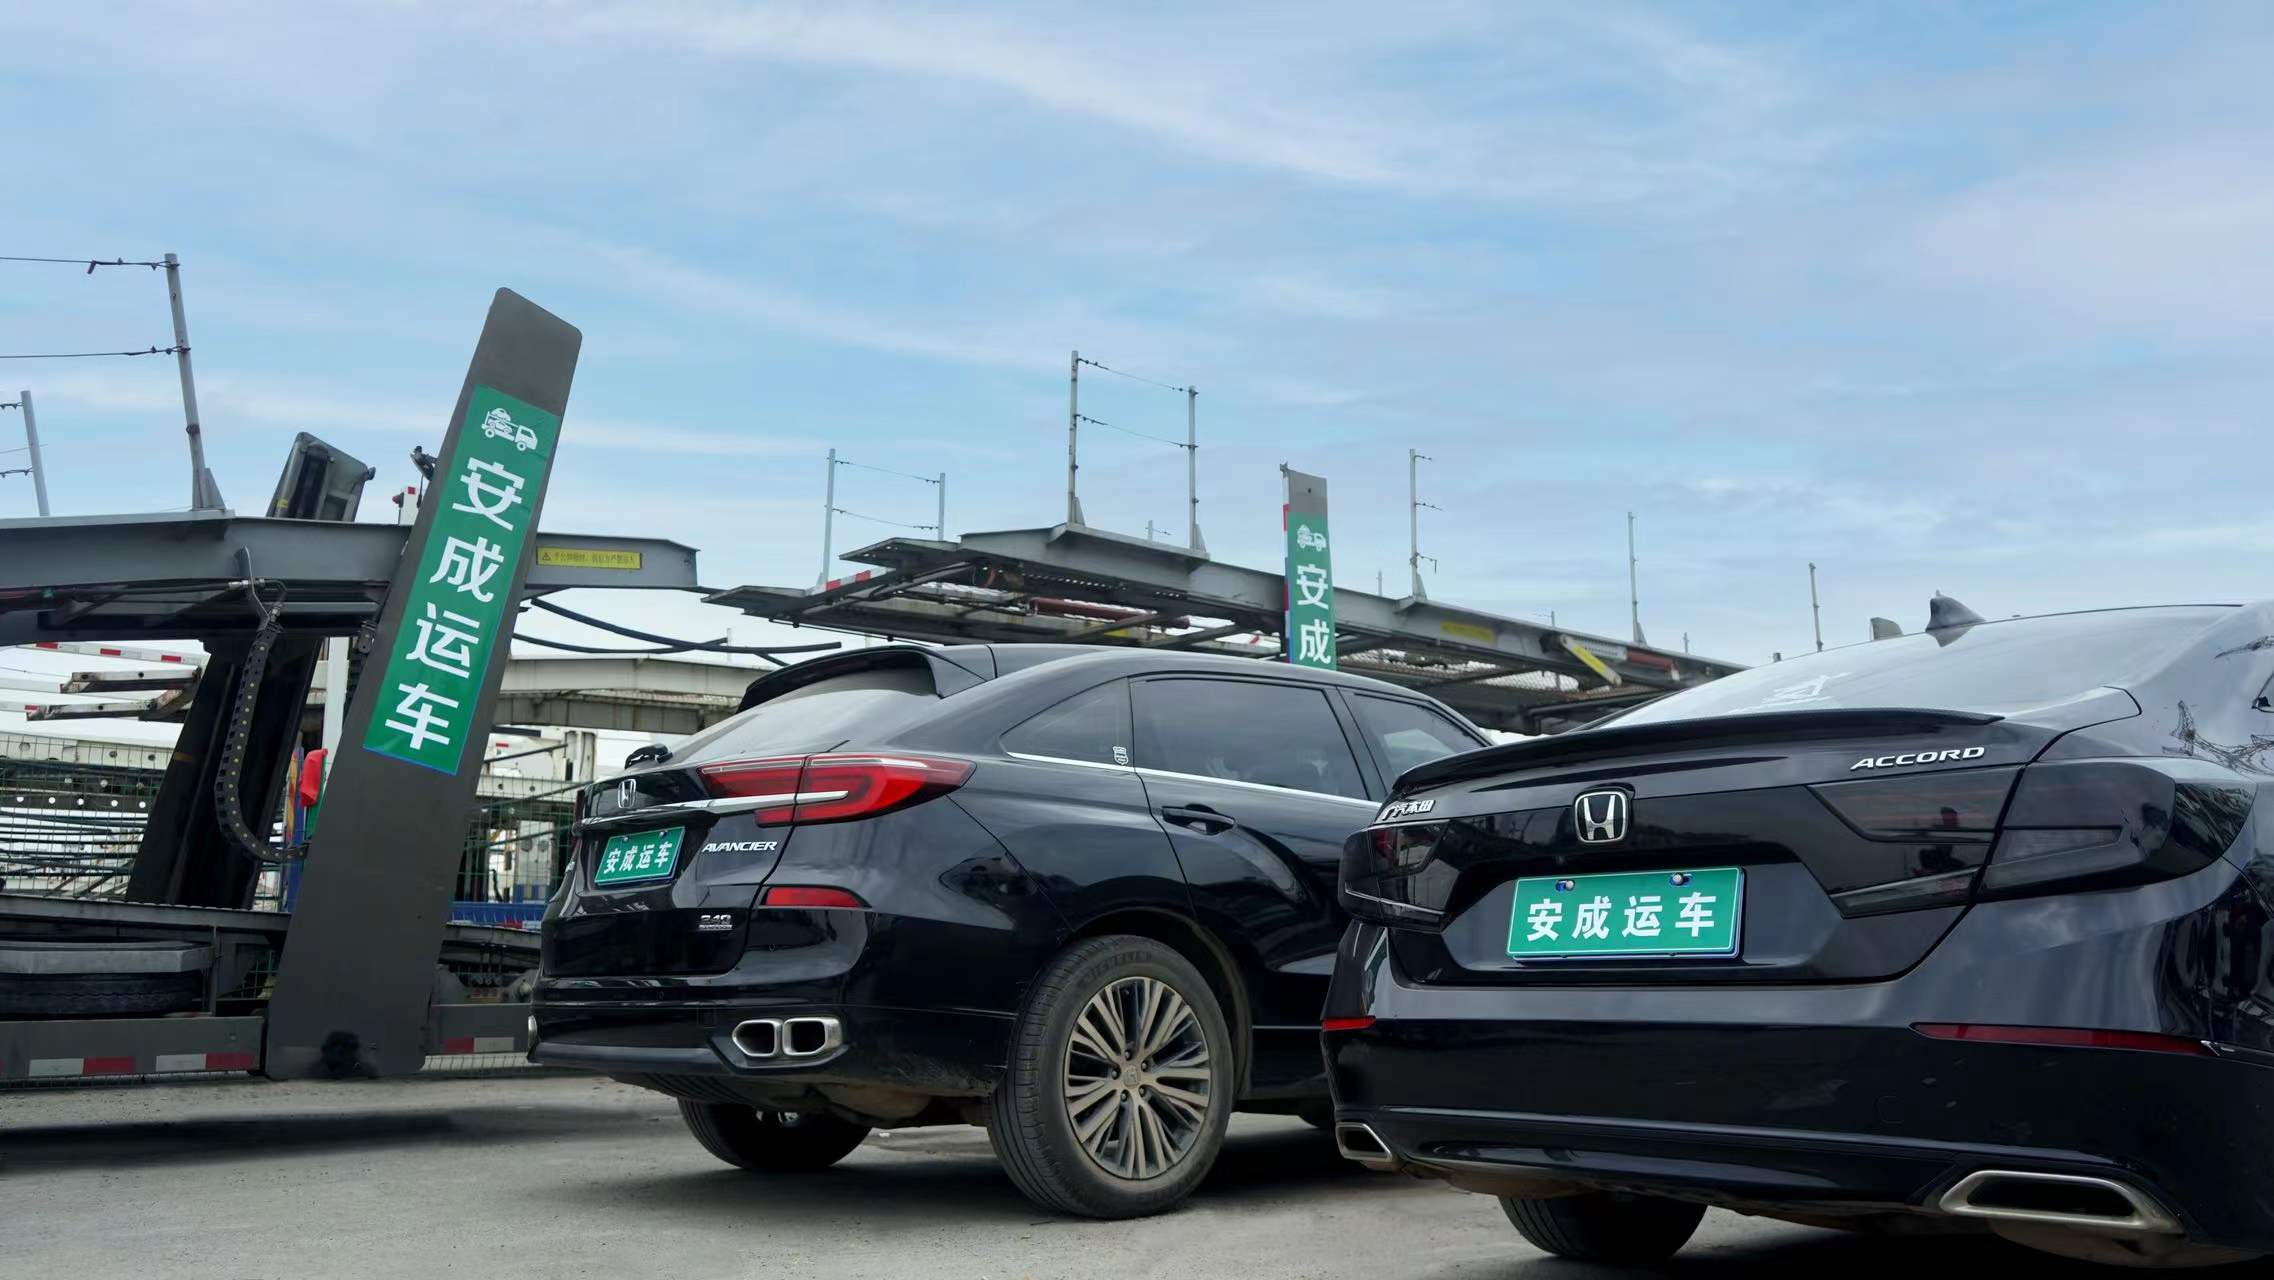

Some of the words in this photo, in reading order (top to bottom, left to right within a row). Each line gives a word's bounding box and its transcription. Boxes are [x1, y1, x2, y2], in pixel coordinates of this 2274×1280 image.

[385, 457, 525, 750] 安成运车
[1296, 563, 1331, 664] 安成
[1850, 746, 1985, 770] ACCORD
[603, 841, 673, 874] 安成运车
[702, 841, 777, 853] AVANCIER
[1525, 892, 1717, 943] 安成运车
